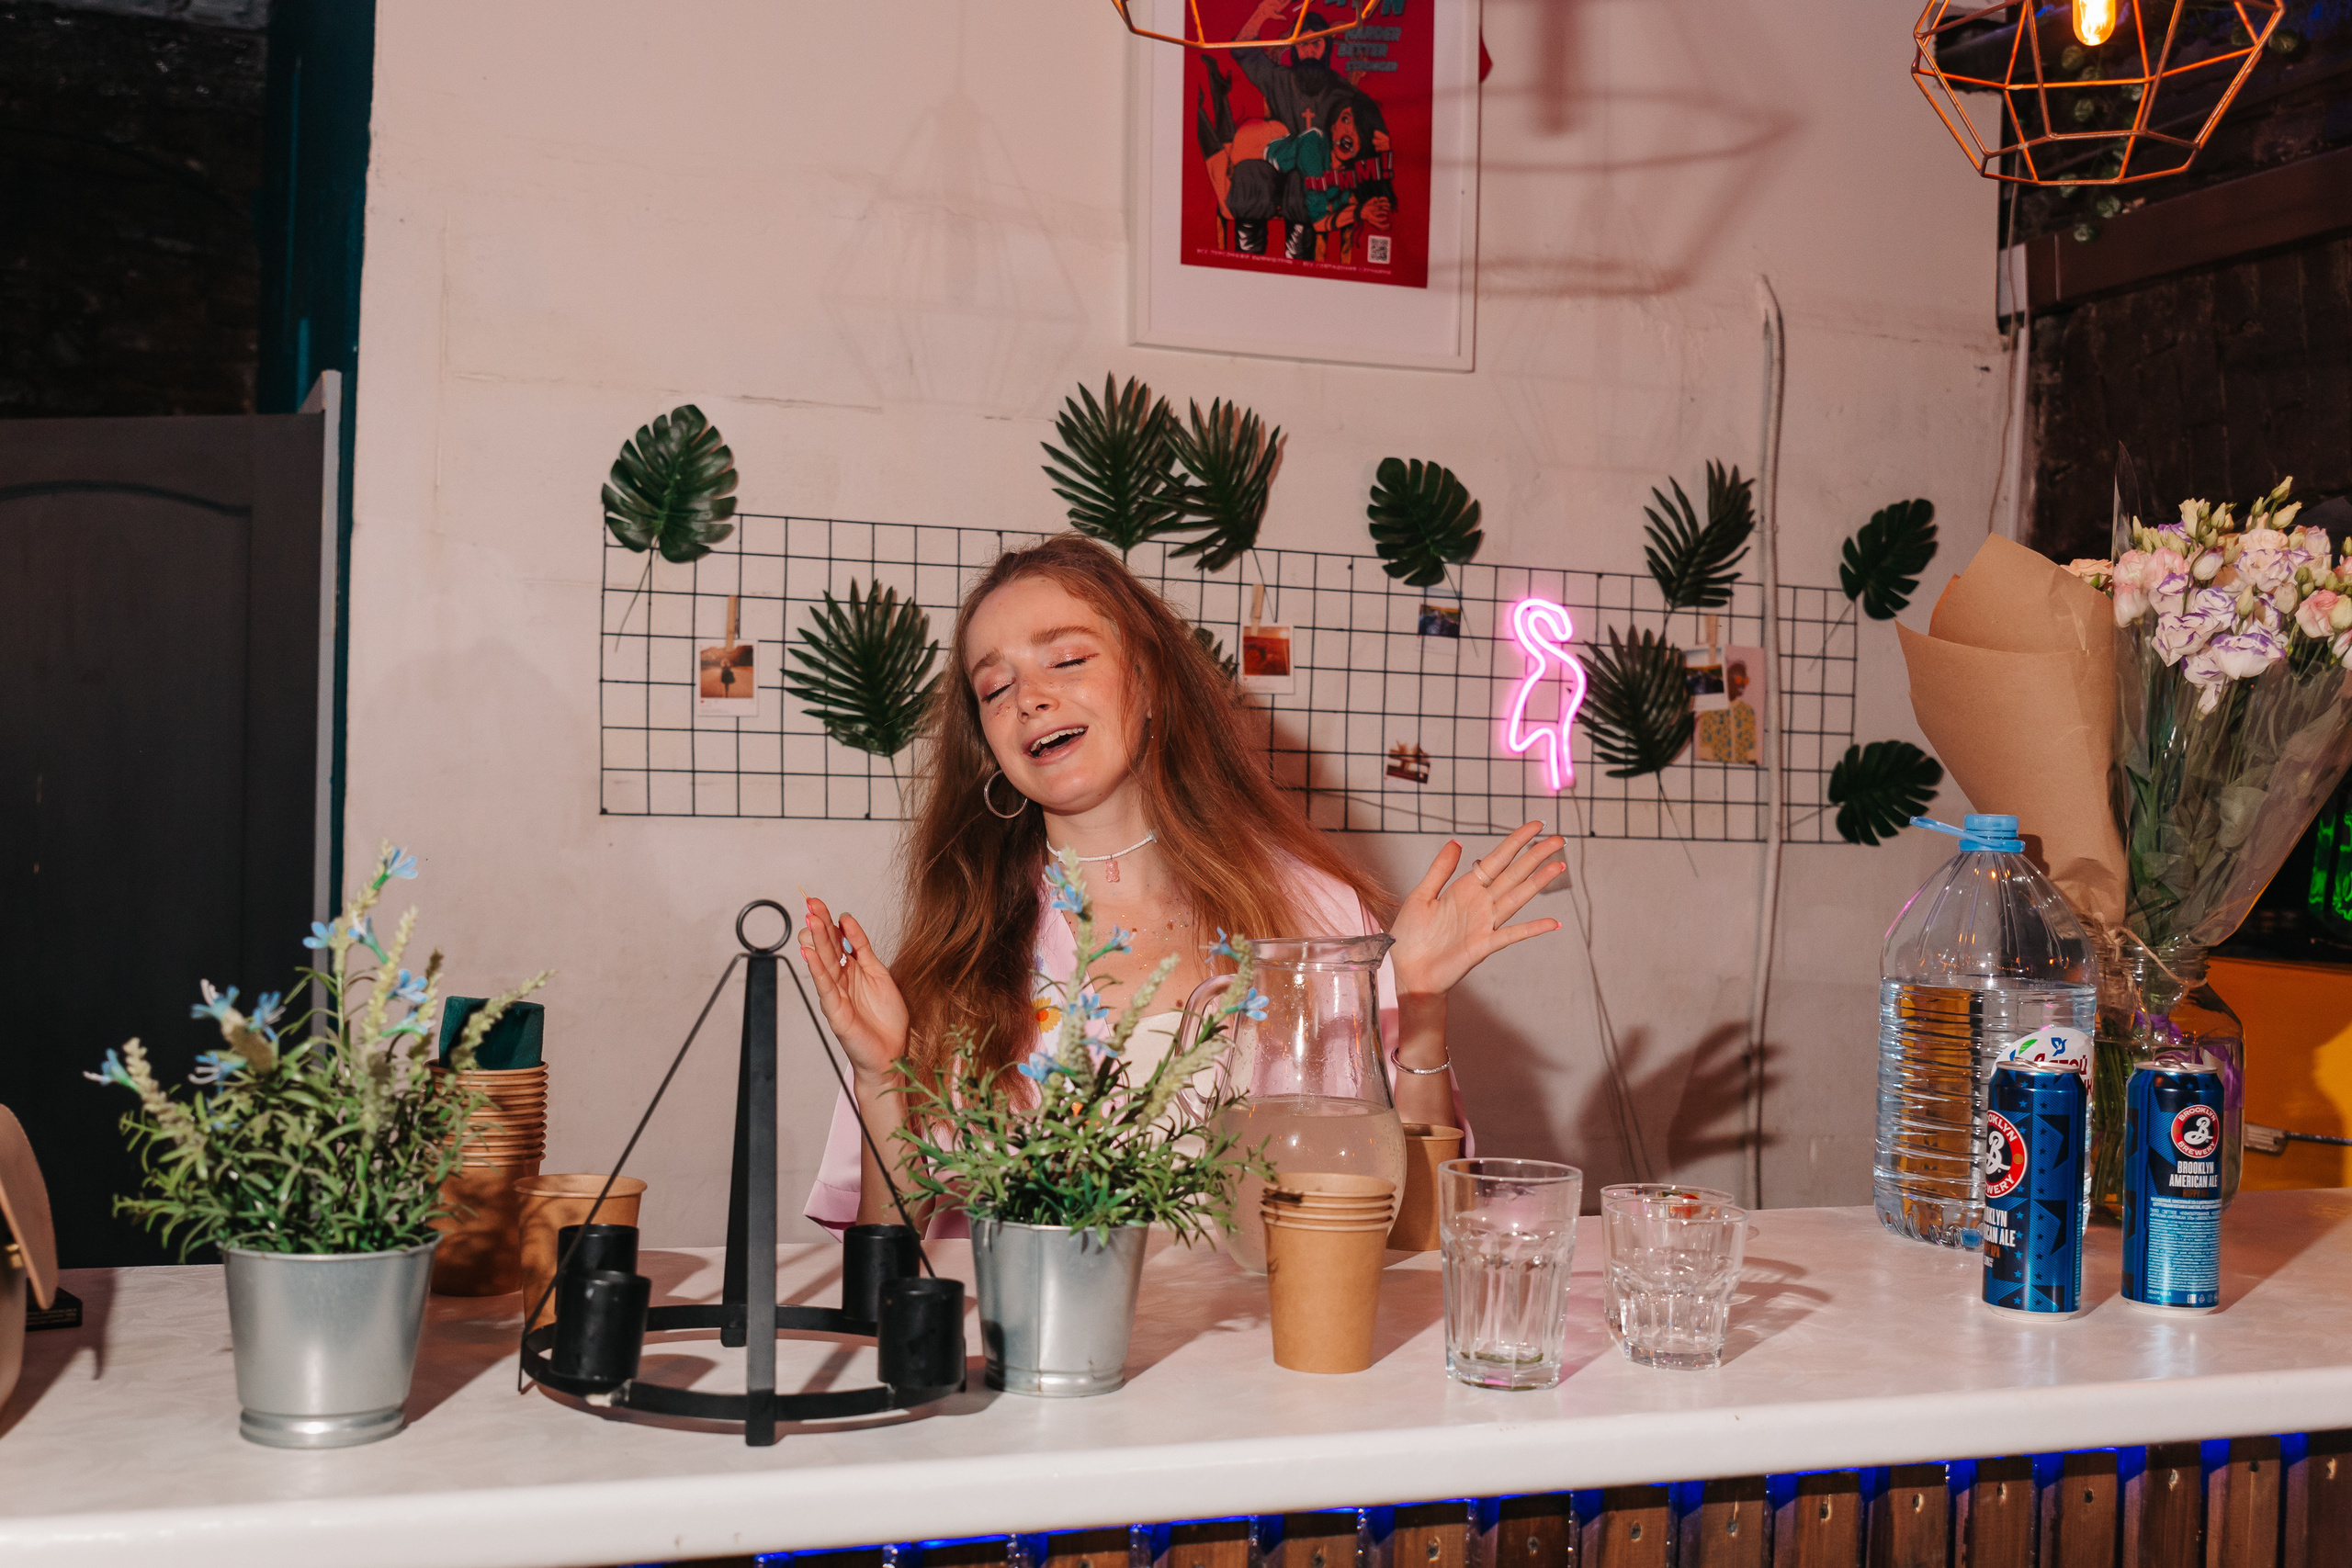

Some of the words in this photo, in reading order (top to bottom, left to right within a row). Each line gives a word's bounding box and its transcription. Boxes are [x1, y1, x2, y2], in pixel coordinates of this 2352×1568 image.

[1337, 43, 1388, 58] BETTER
[2177, 1106, 2216, 1122] BROOKLYN
[1986, 1113, 2018, 1143] OKLYN
[2177, 1141, 2215, 1156] BREWERY
[2177, 1160, 2214, 1175] BROOKLYN
[1985, 1174, 2015, 1195] WERY
[2168, 1174, 2207, 1189] AMERICAN
[2208, 1175, 2218, 1188] ALE
[1999, 1228, 2017, 1247] ALE
